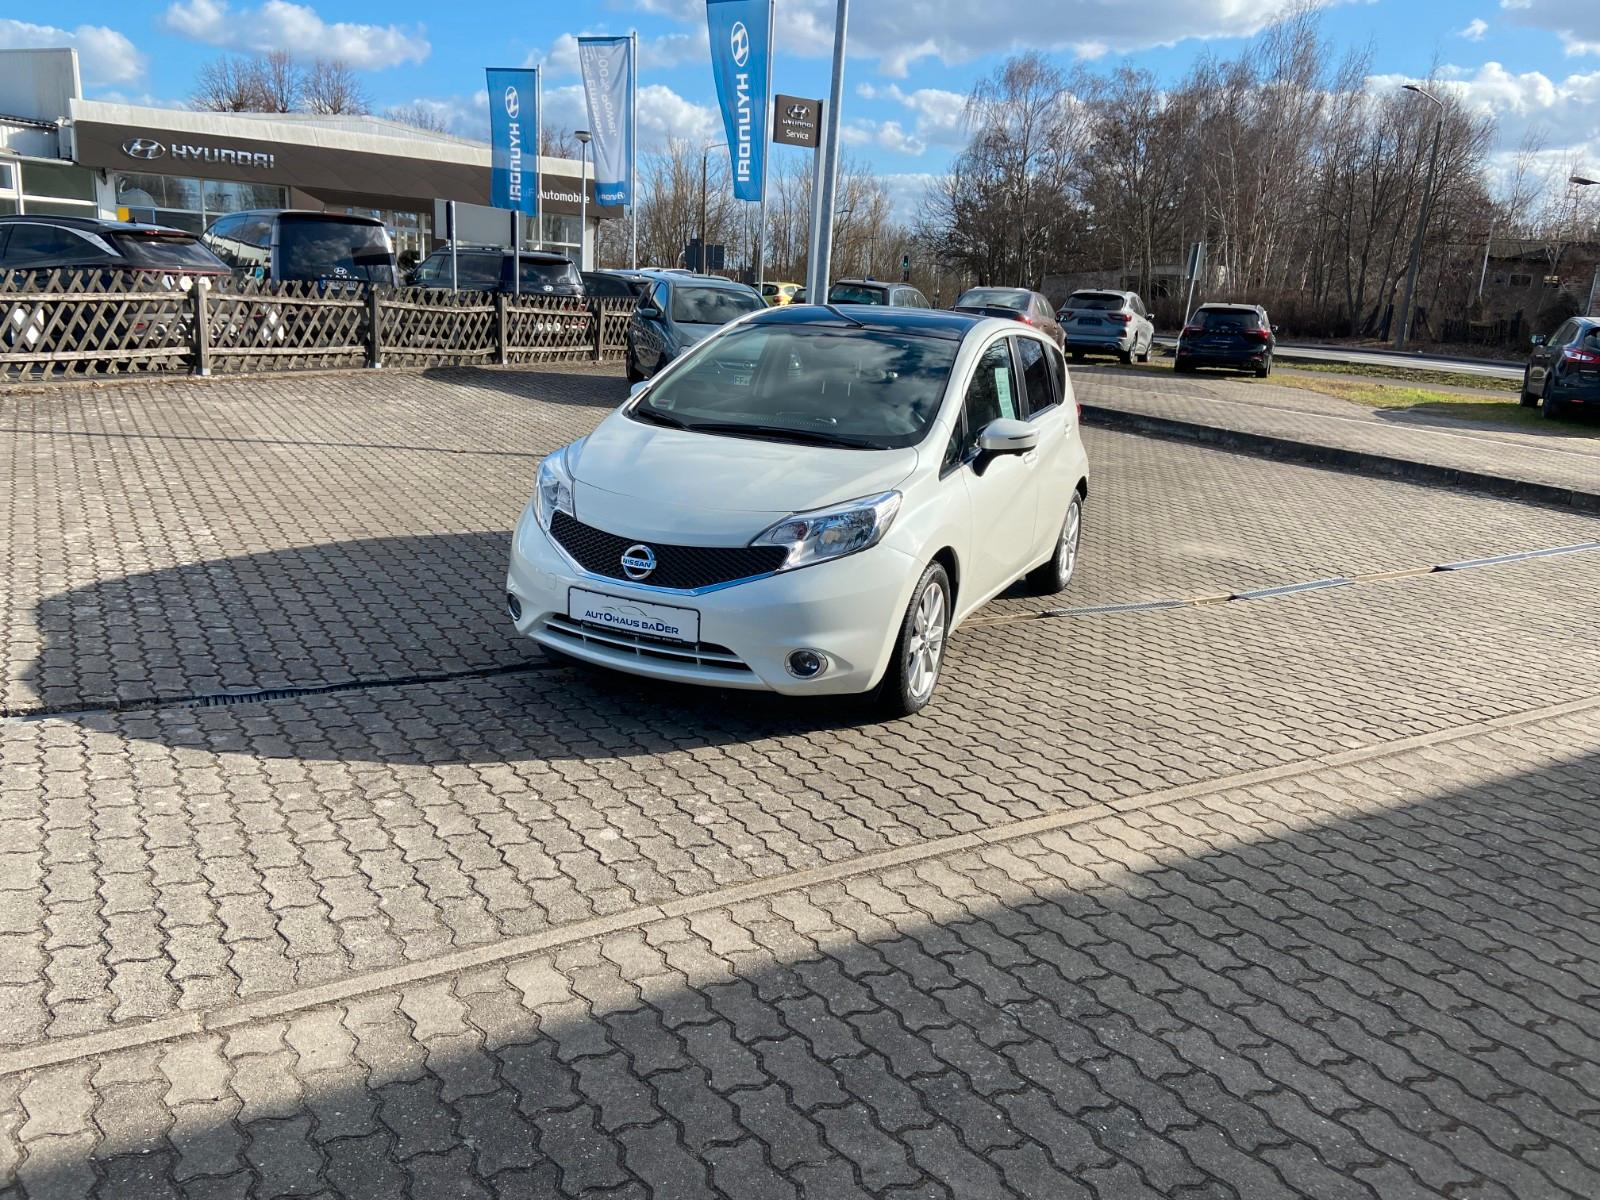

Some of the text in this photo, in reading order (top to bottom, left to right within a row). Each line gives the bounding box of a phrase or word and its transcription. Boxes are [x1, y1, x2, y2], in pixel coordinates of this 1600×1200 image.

[786, 129, 809, 140] Service
[171, 143, 275, 169] HYUNDAI
[537, 189, 590, 204] Automobie
[622, 557, 652, 568] NISSAN
[585, 609, 640, 628] AUTOHAUS
[641, 621, 679, 635] BADER
